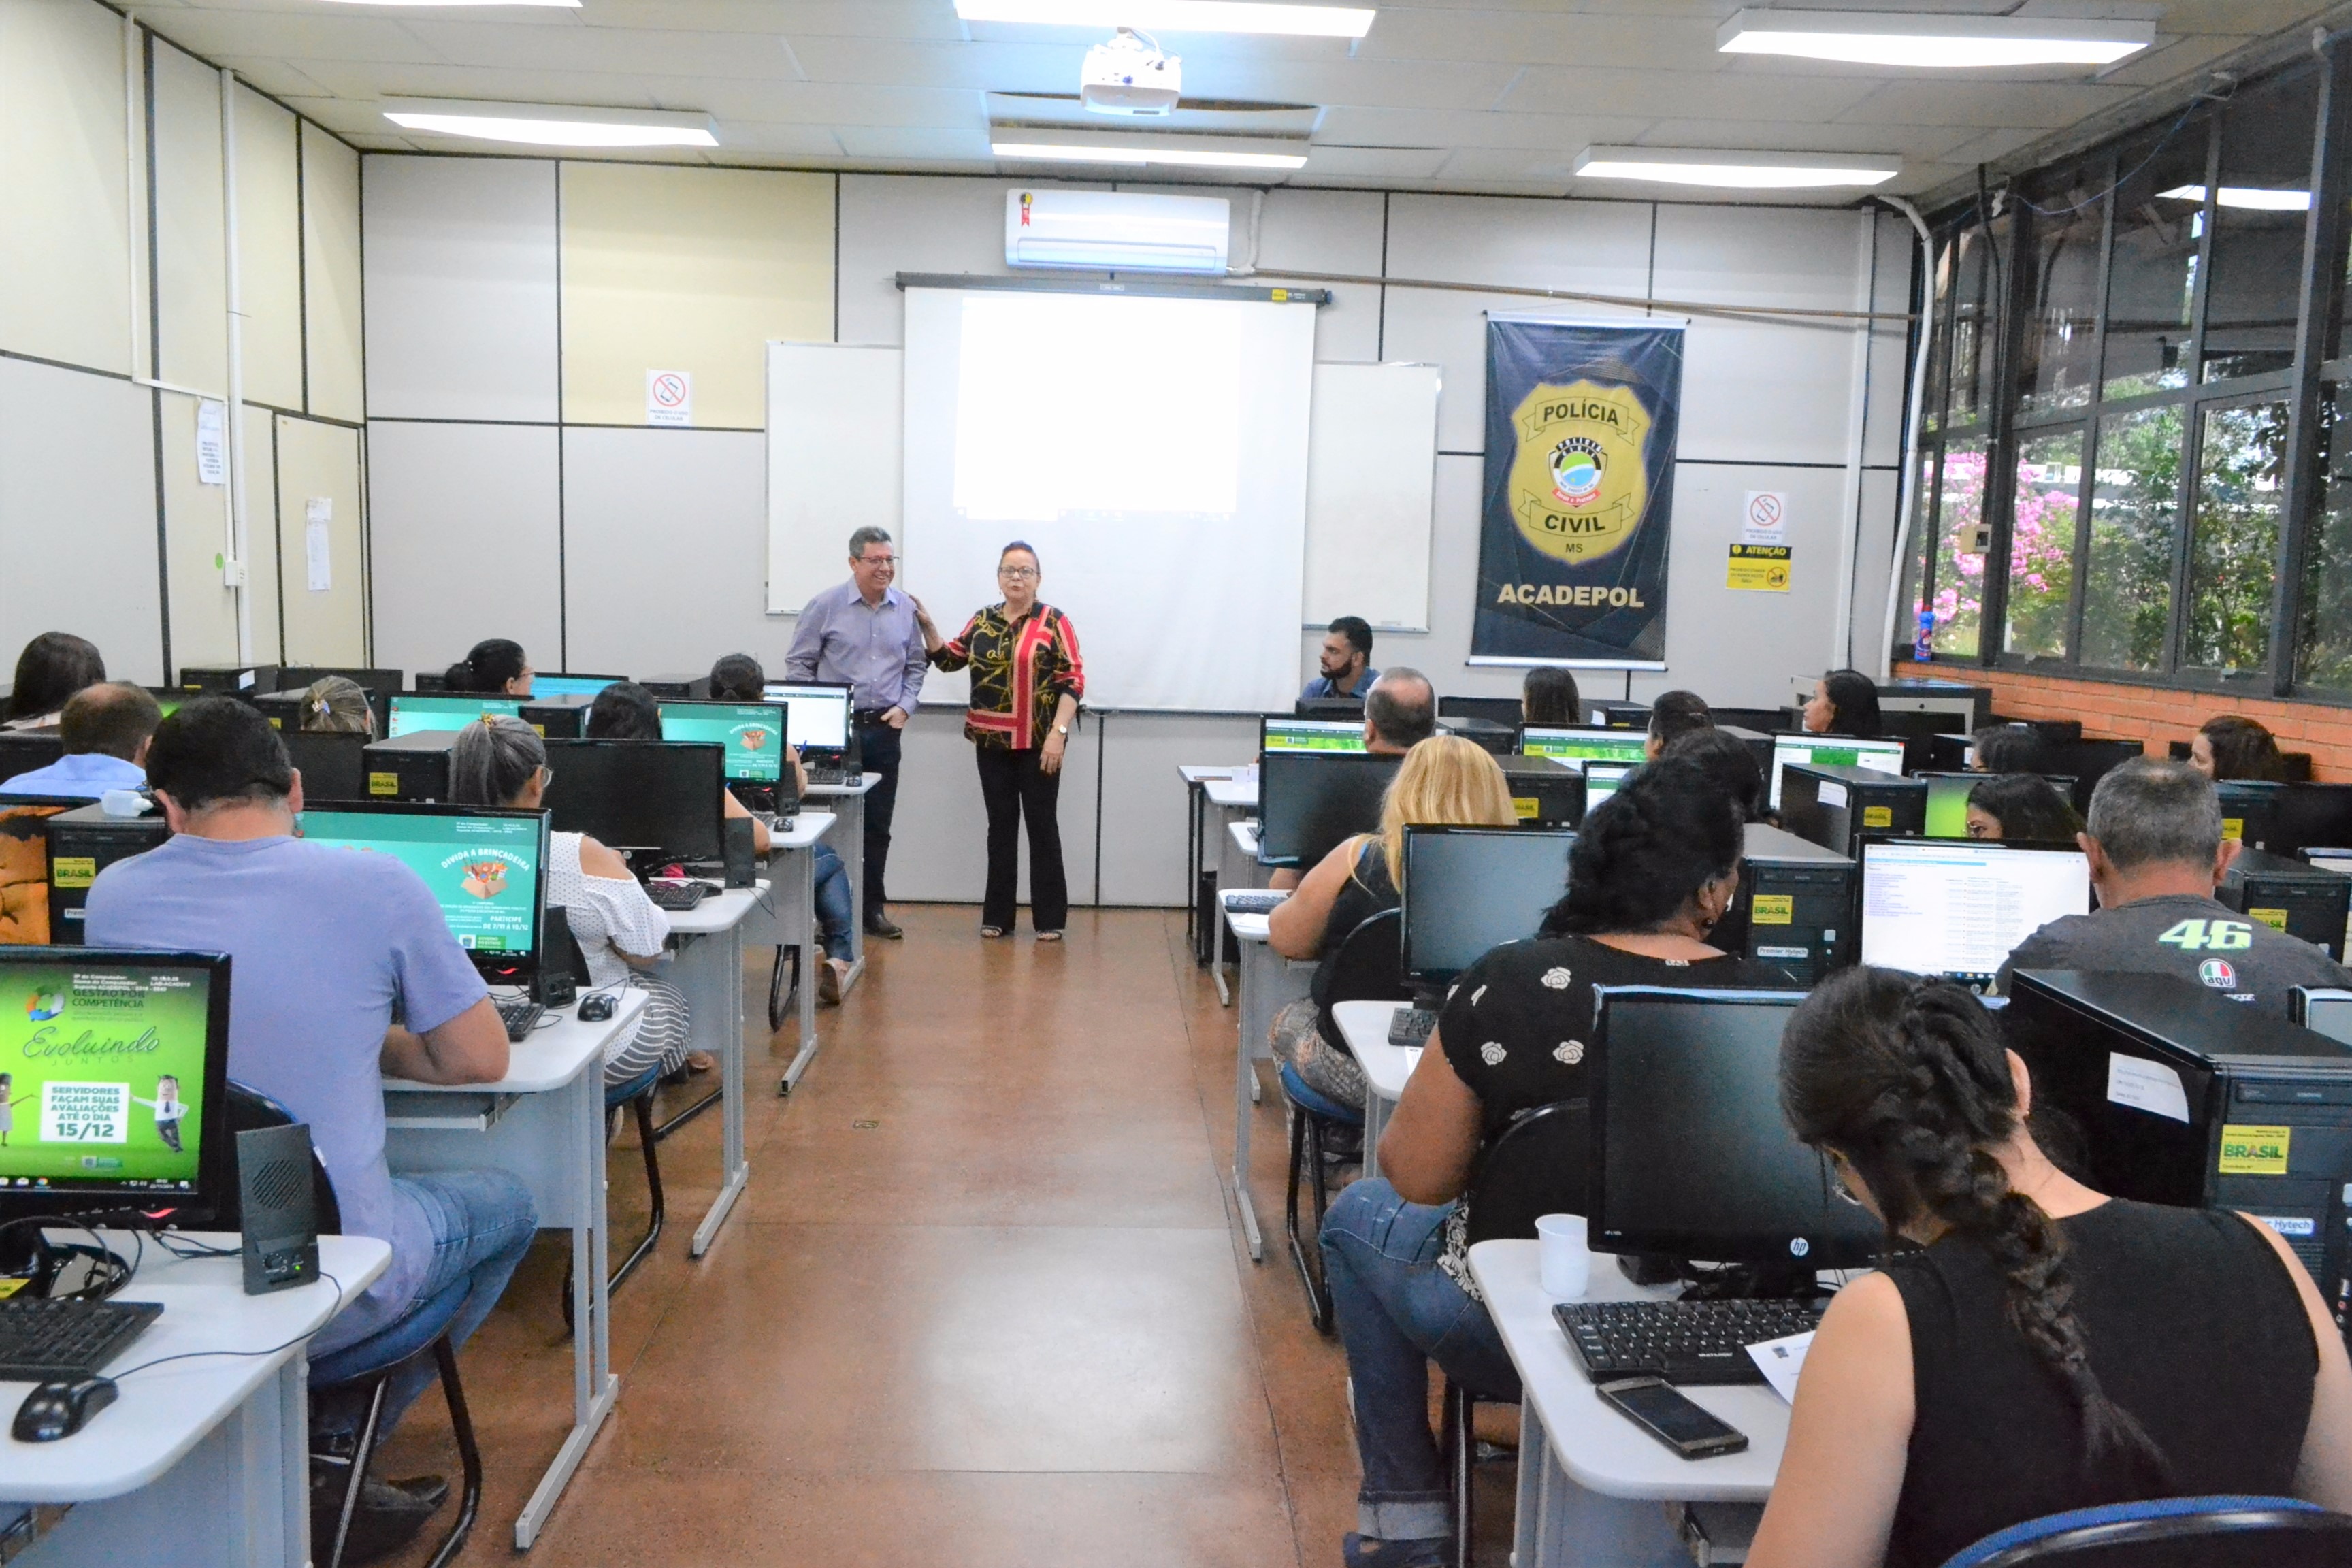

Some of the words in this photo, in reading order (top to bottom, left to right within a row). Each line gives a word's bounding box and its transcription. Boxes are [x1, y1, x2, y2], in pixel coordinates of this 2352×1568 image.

[1543, 398, 1619, 425] POLÍCIA
[1544, 514, 1606, 533] CIVIL
[1565, 543, 1584, 553] MS
[1746, 546, 1786, 557] ATENÇÃO
[1497, 583, 1644, 608] ACADEPOL
[441, 850, 469, 869] DIVIDA
[470, 849, 476, 857] A
[478, 848, 531, 872] BRINCADEIRA
[56, 869, 93, 878] BRASIL
[1754, 906, 1789, 915] BRASIL
[2159, 919, 2252, 949] 46
[2207, 976, 2231, 986] agv
[120, 990, 145, 998] POR
[72, 997, 144, 1008] COMPETÊNCIA
[22, 1025, 161, 1058] Evoluindo
[52, 1055, 135, 1067] JUNTOS
[52, 1086, 120, 1095] SERVIDORES
[51, 1095, 90, 1105] FAÇAM
[92, 1096, 120, 1104] SUAS
[51, 1102, 119, 1113] AVALIAÇÕES
[58, 1111, 80, 1121] ATÉ
[56, 1122, 115, 1140] 15/12
[2223, 1143, 2283, 1158] BRASIL
[2274, 1220, 2310, 1230] Hytech
[1793, 1237, 1806, 1256] hp
